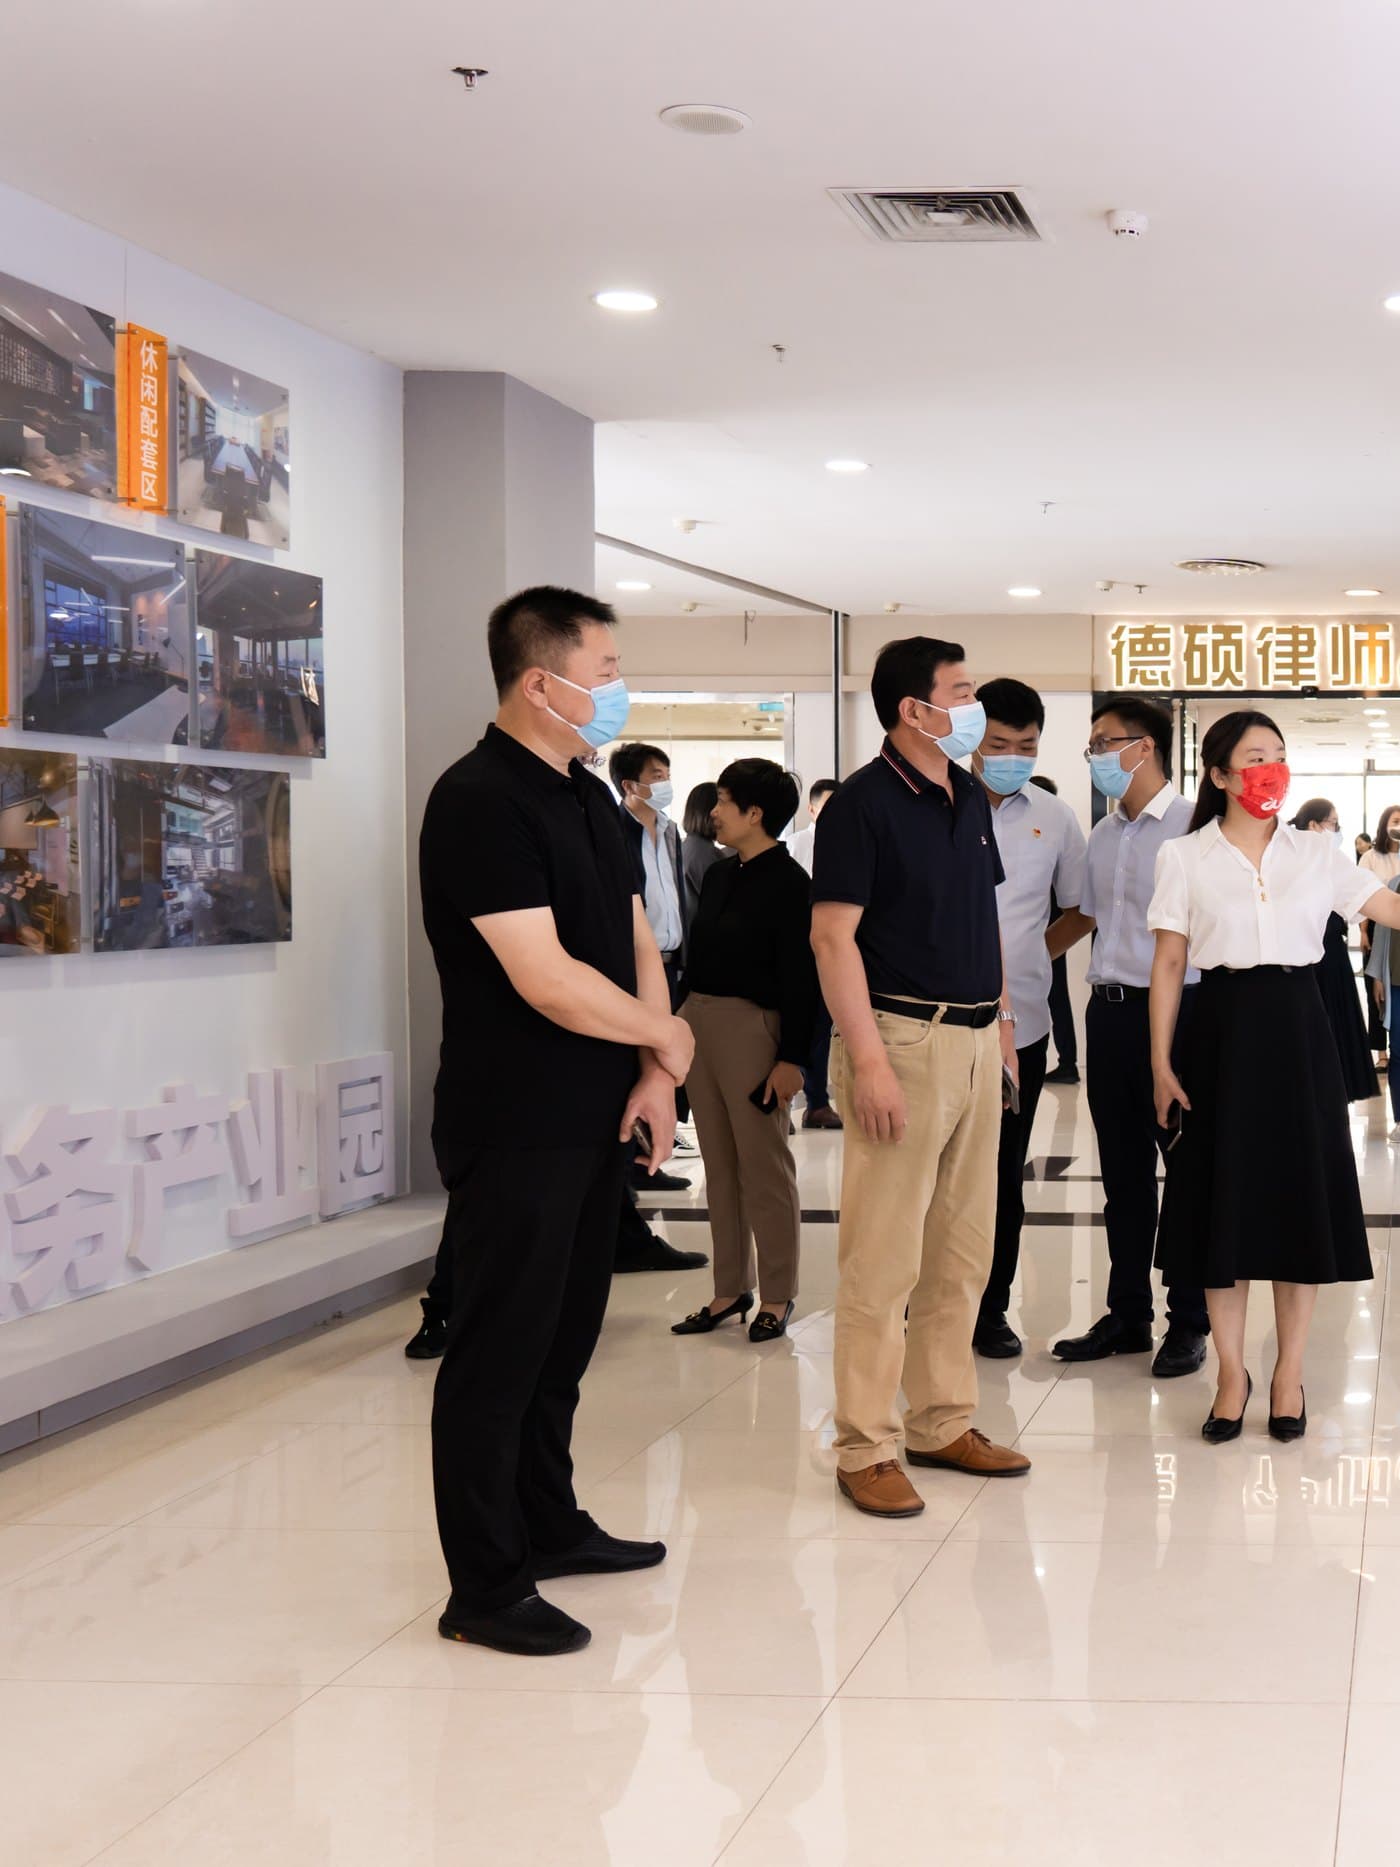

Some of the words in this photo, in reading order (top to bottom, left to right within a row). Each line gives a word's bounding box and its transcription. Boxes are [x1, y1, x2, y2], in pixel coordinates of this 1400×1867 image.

[140, 340, 158, 502] 休闲配套区
